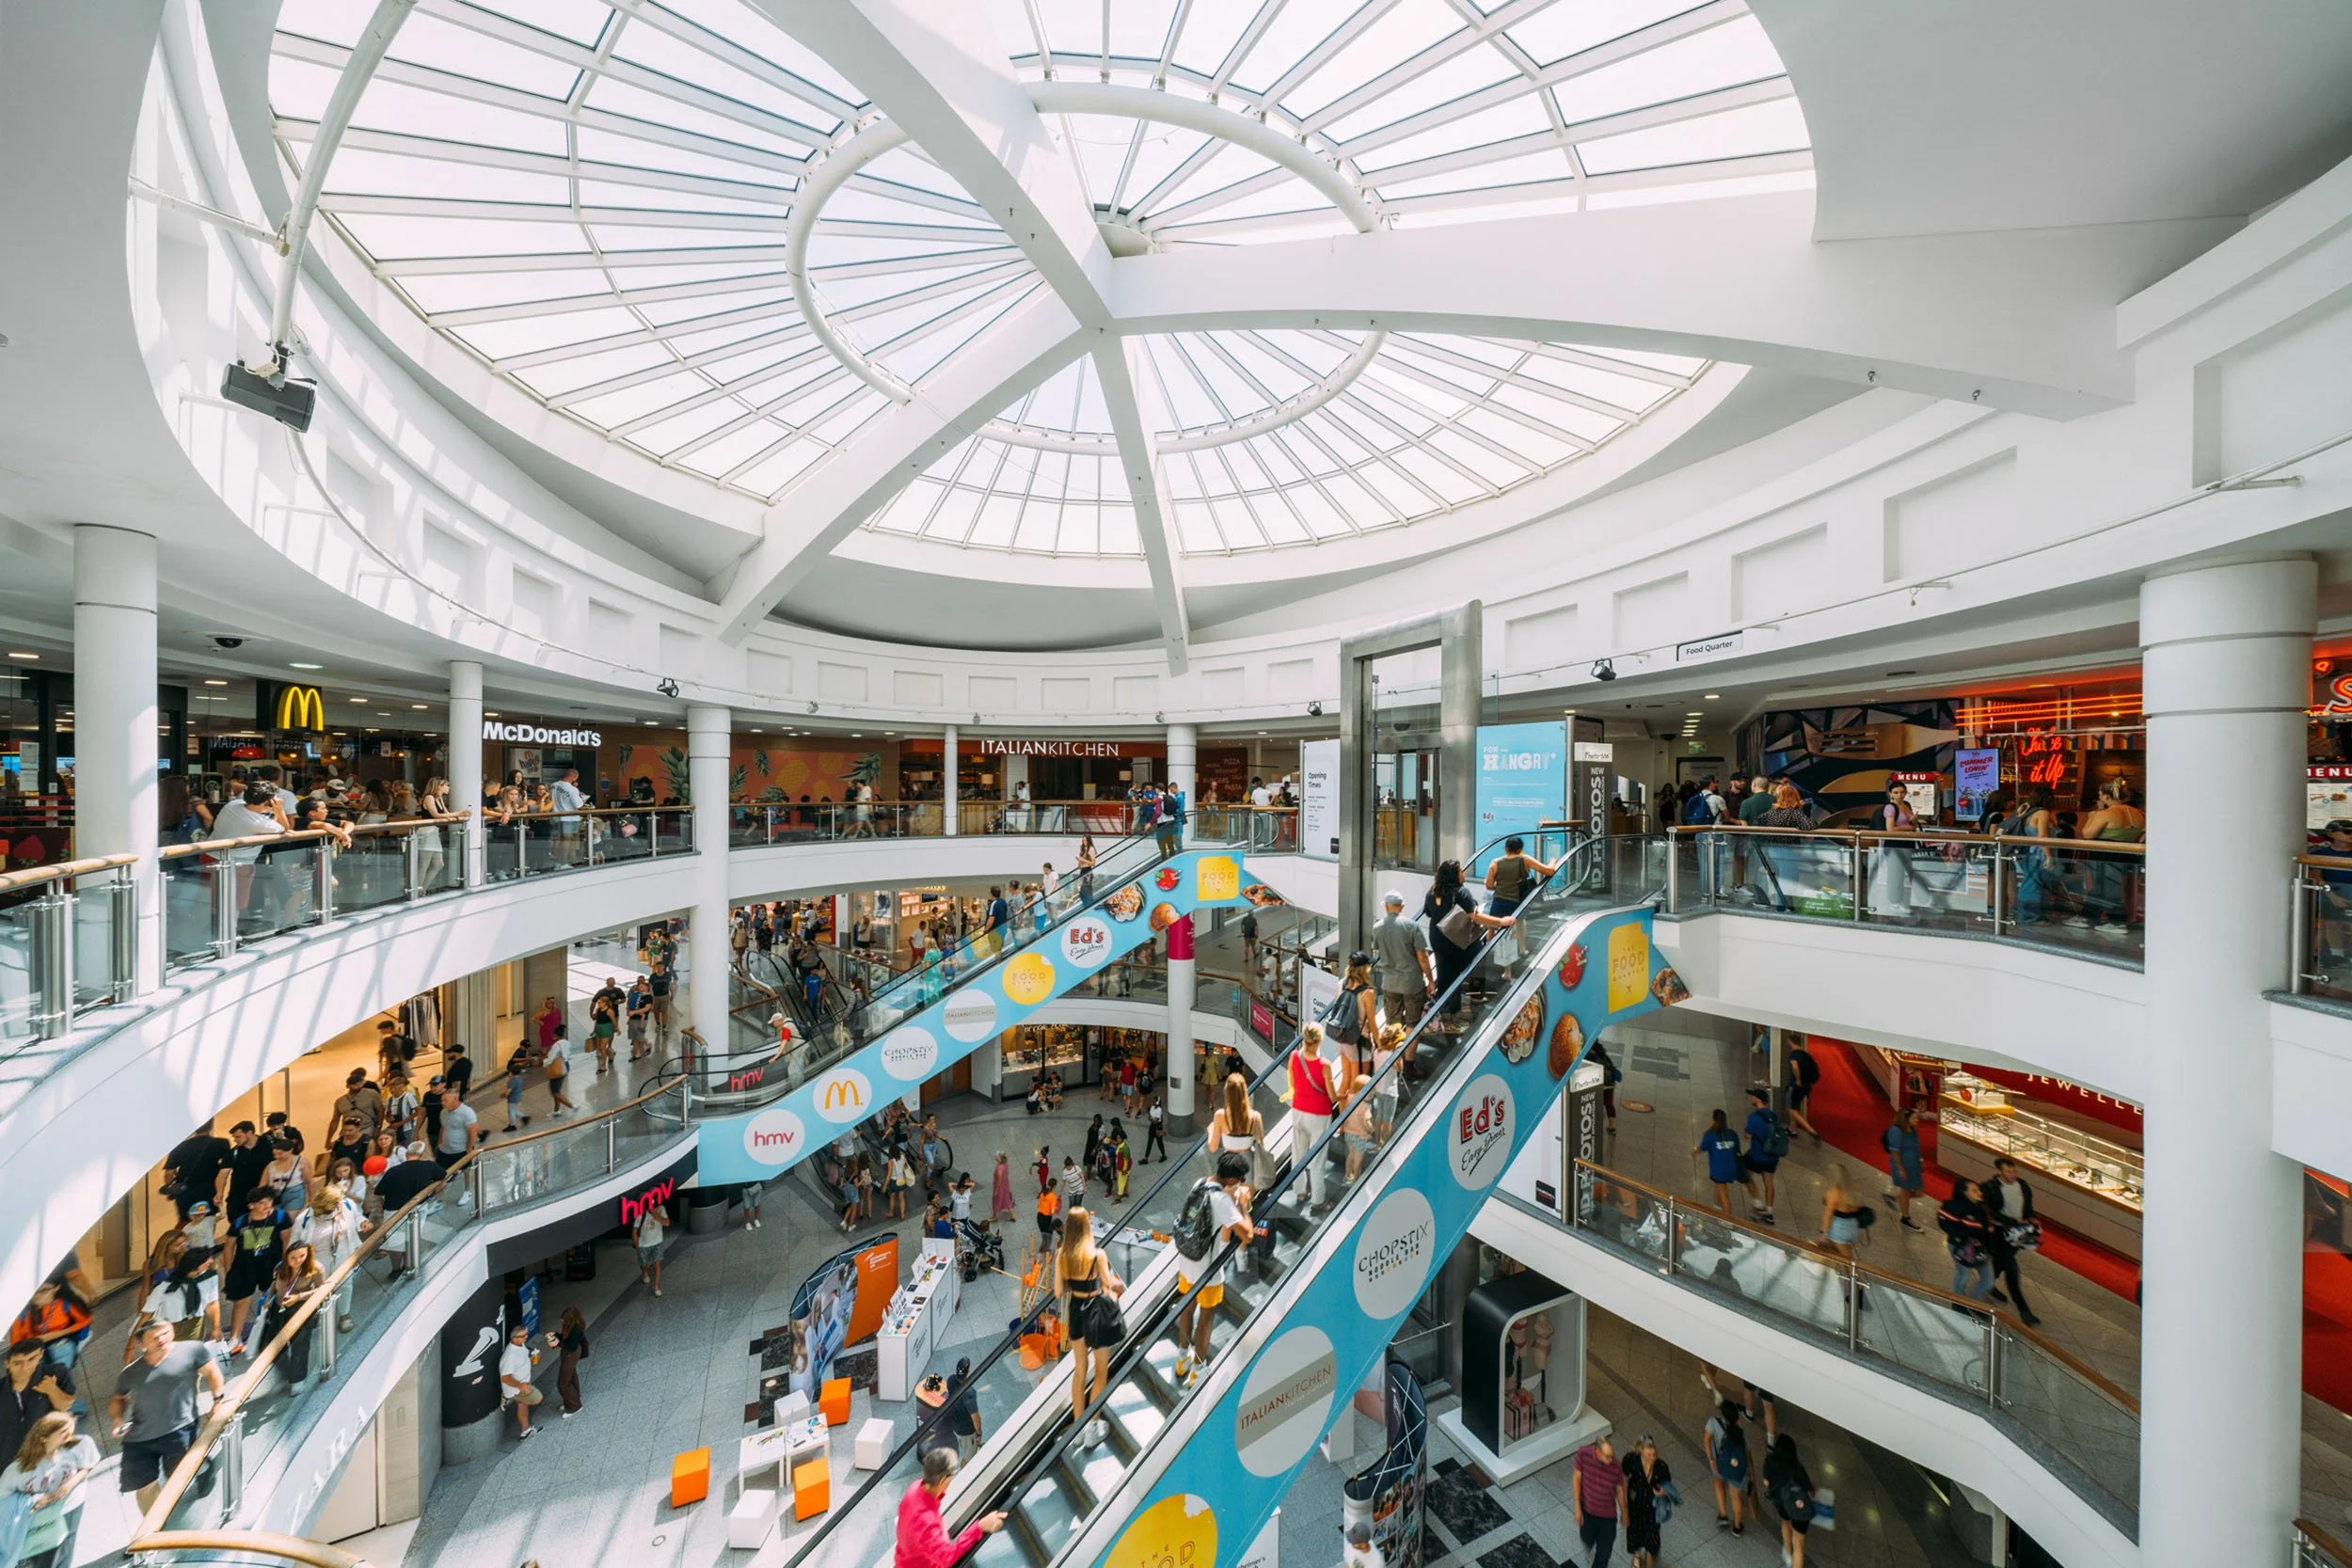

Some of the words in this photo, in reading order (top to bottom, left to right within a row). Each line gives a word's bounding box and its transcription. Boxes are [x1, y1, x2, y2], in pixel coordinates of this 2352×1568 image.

[1686, 645, 1704, 655] Food
[1705, 641, 1733, 653] Quarter
[483, 721, 602, 747] McDonald's
[981, 740, 1119, 756] ITALIANKITCHEN
[1309, 772, 1327, 781] Opening
[1592, 868, 1602, 889] ID
[1071, 927, 1104, 944] Ed's
[1613, 951, 1645, 974] FOOD
[884, 1045, 933, 1056] CHOPSTIX
[730, 1067, 765, 1093] hmv
[1581, 1092, 1596, 1104] NEW
[1460, 1096, 1505, 1145] Ed's
[755, 1131, 794, 1147] hmv
[1461, 1148, 1483, 1171] Easy
[622, 1177, 675, 1225] hmv
[1359, 1221, 1428, 1272] CHOPSTIX
[1241, 1364, 1331, 1430] ITALIANKITCHEN
